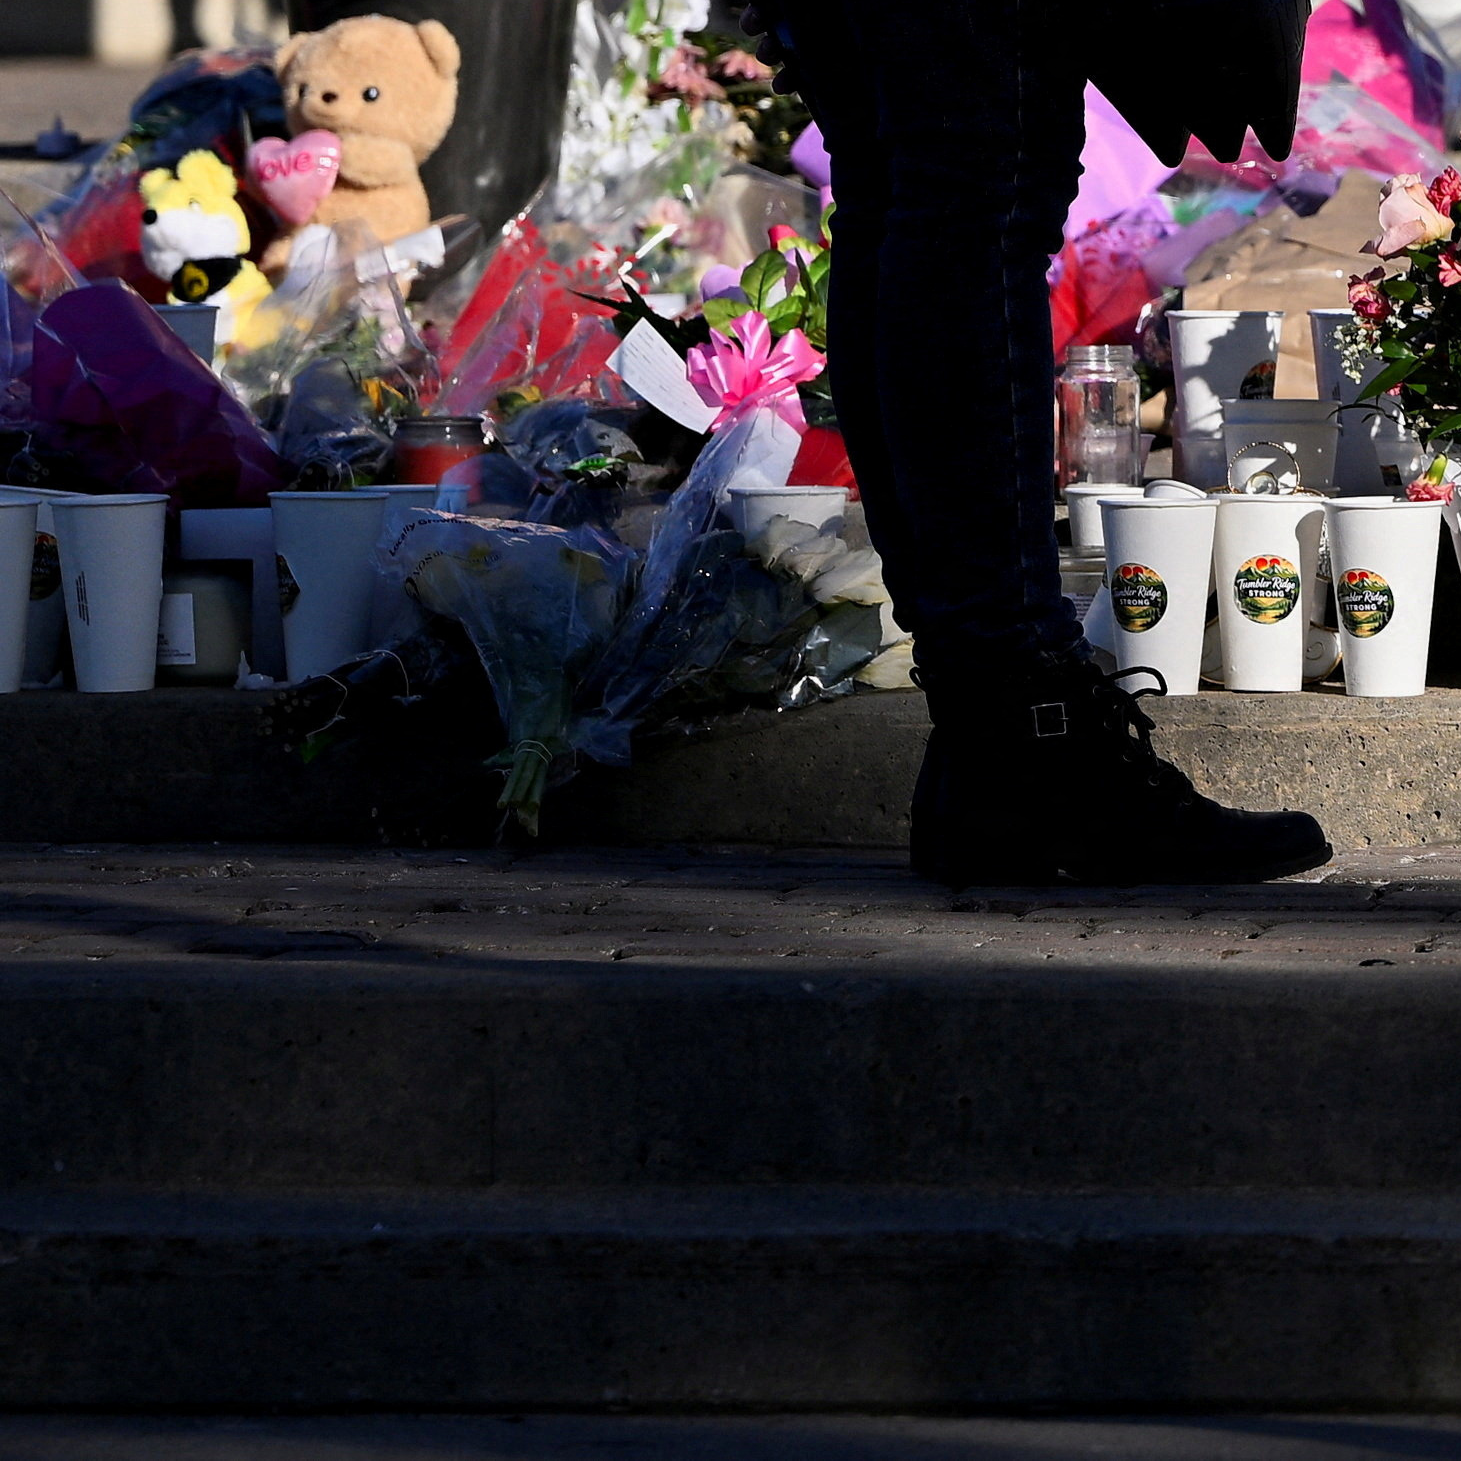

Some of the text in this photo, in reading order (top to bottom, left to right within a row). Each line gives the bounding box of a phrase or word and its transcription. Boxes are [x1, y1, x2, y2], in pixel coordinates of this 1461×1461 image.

[388, 522, 416, 557] Locally
[1237, 577, 1296, 592] Tumbler Ridge
[1136, 585, 1161, 600] Ridge
[1249, 589, 1284, 597] STRONG
[1362, 591, 1388, 606] Ridge
[1119, 597, 1150, 606] STRONG
[1346, 604, 1377, 612] STRONG
